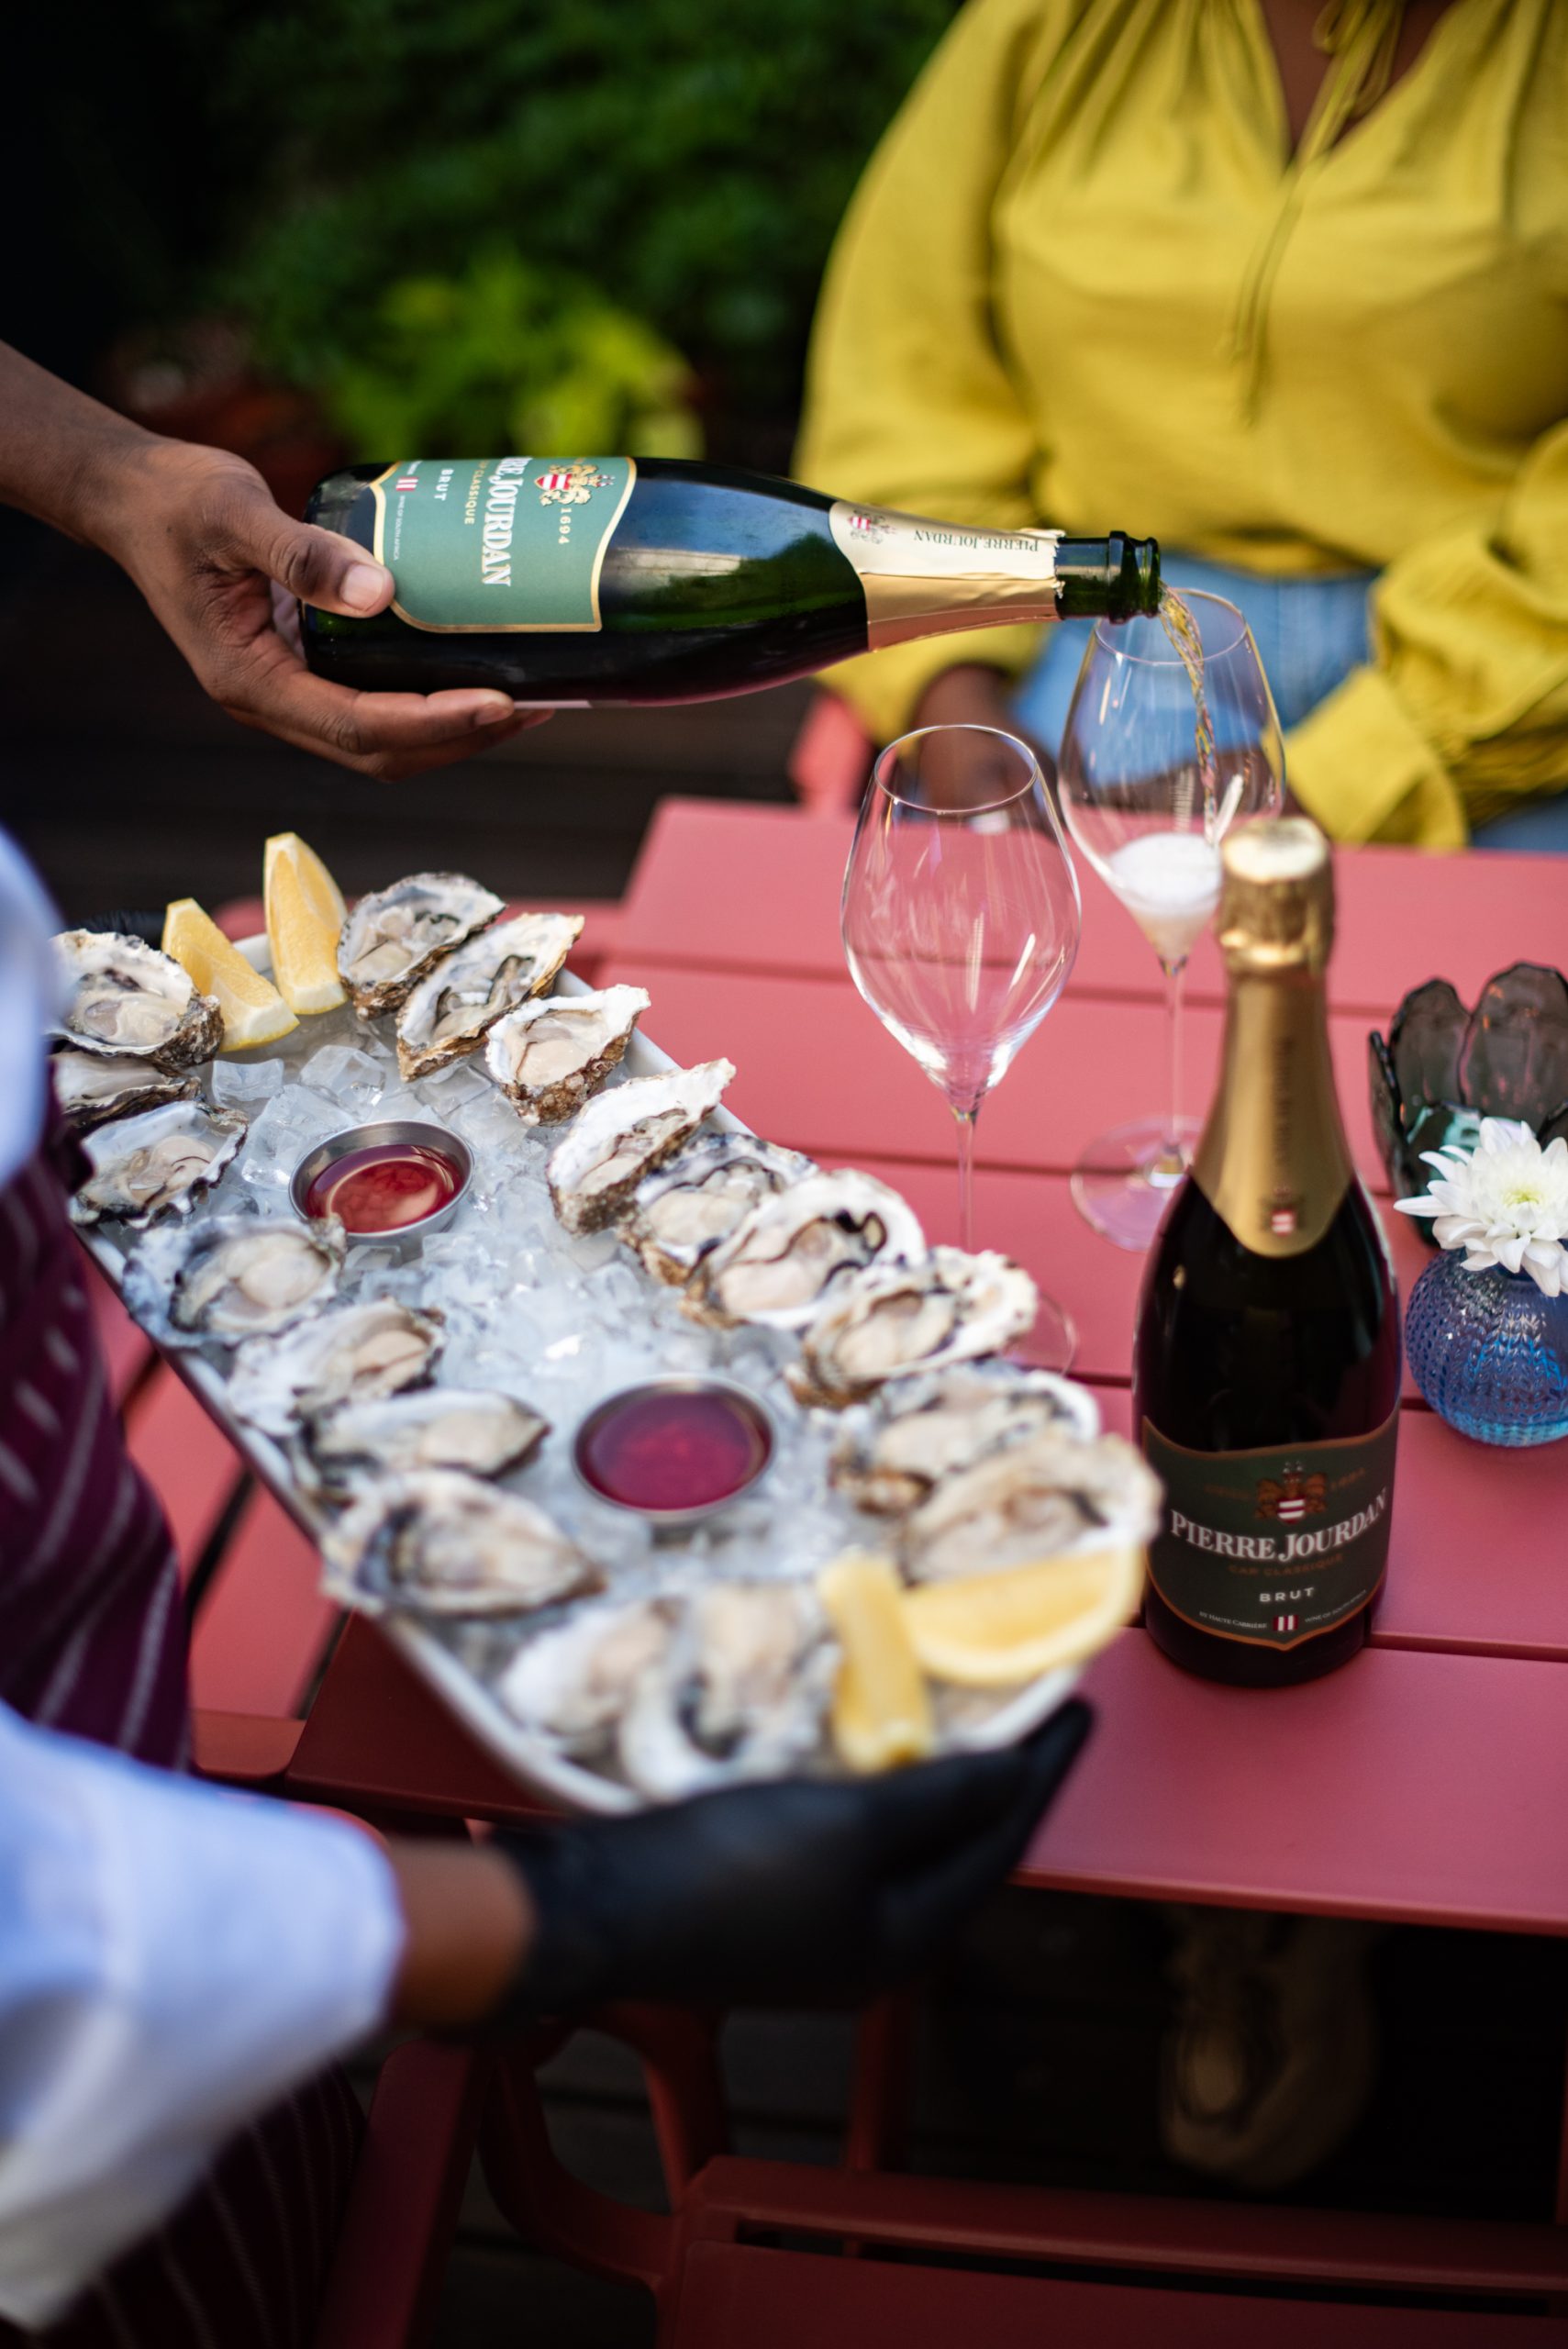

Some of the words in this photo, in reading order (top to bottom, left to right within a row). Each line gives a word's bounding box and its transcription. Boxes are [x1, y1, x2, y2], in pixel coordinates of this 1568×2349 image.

[433, 468, 454, 502] BRUT
[464, 470, 485, 525] CLASSIQUE
[482, 475, 524, 586] JOURDAN
[558, 507, 573, 545] 1694
[913, 529, 982, 550] JOURDAN
[984, 539, 1039, 552] PIERRE
[1170, 1508, 1276, 1561] PIERRE
[1277, 1486, 1387, 1563] JOURDAN
[1259, 1586, 1316, 1603] BRUT
